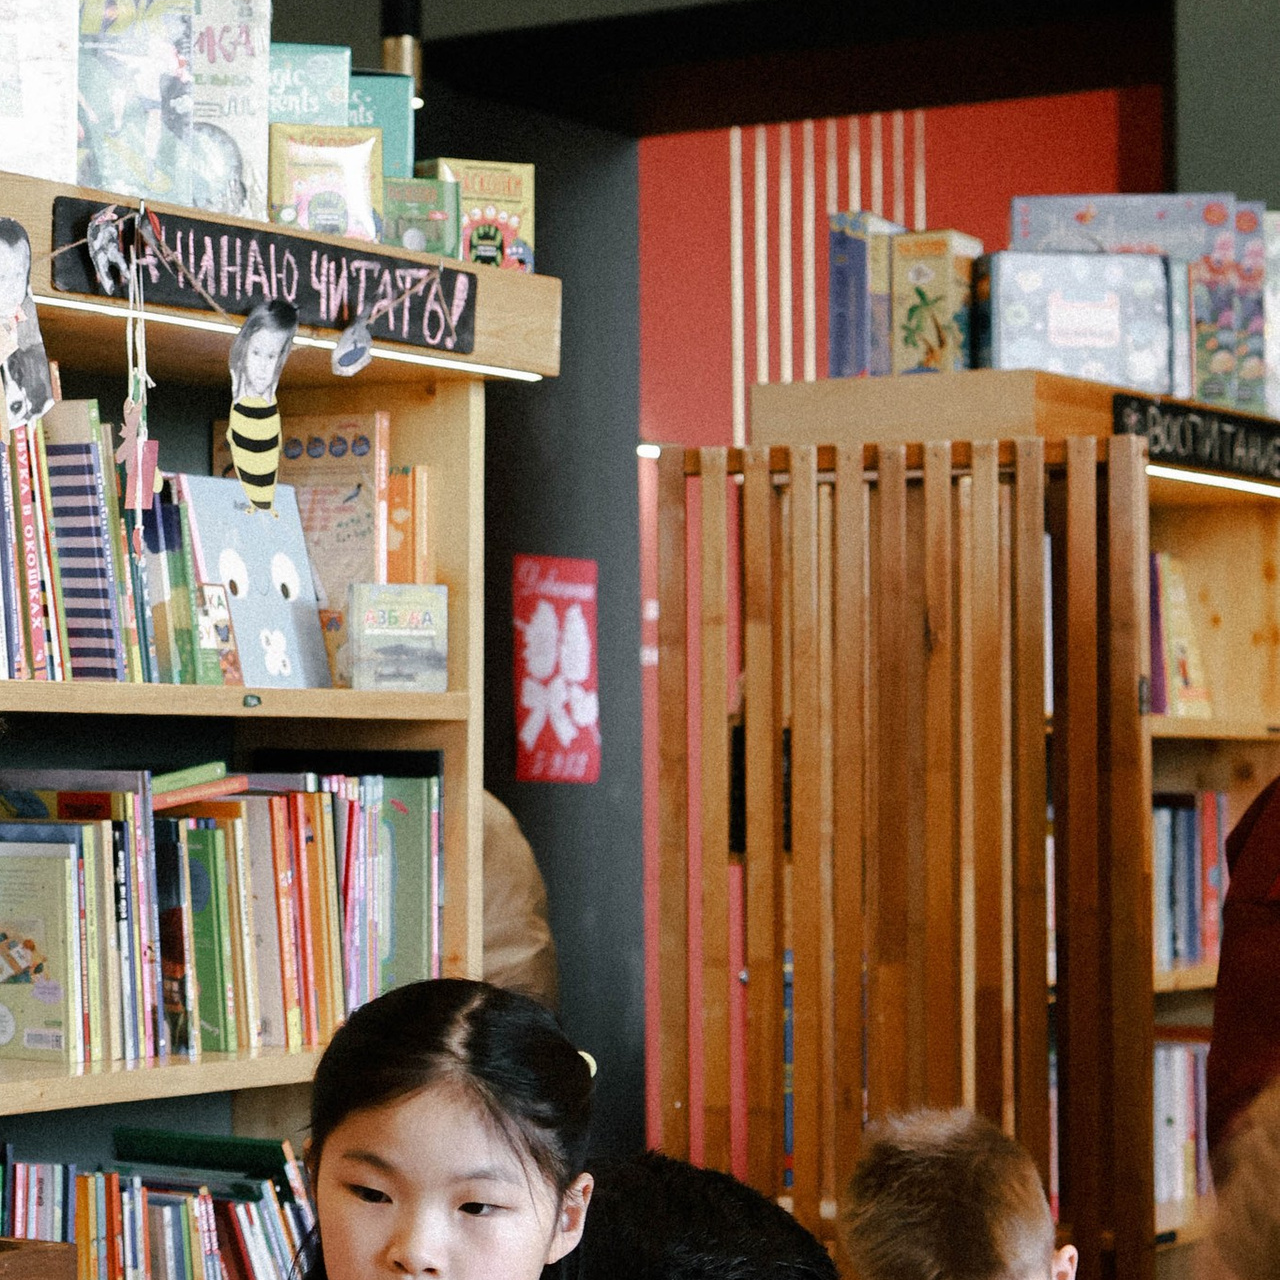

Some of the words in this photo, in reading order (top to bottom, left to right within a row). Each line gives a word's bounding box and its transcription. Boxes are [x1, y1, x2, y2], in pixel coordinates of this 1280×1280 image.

[136, 225, 298, 301] ЧИНАЮ
[311, 250, 469, 349] ЧИТАТЬ!
[17, 431, 29, 495] ЗБУКА
[24, 524, 41, 629] ОКОШКАХ
